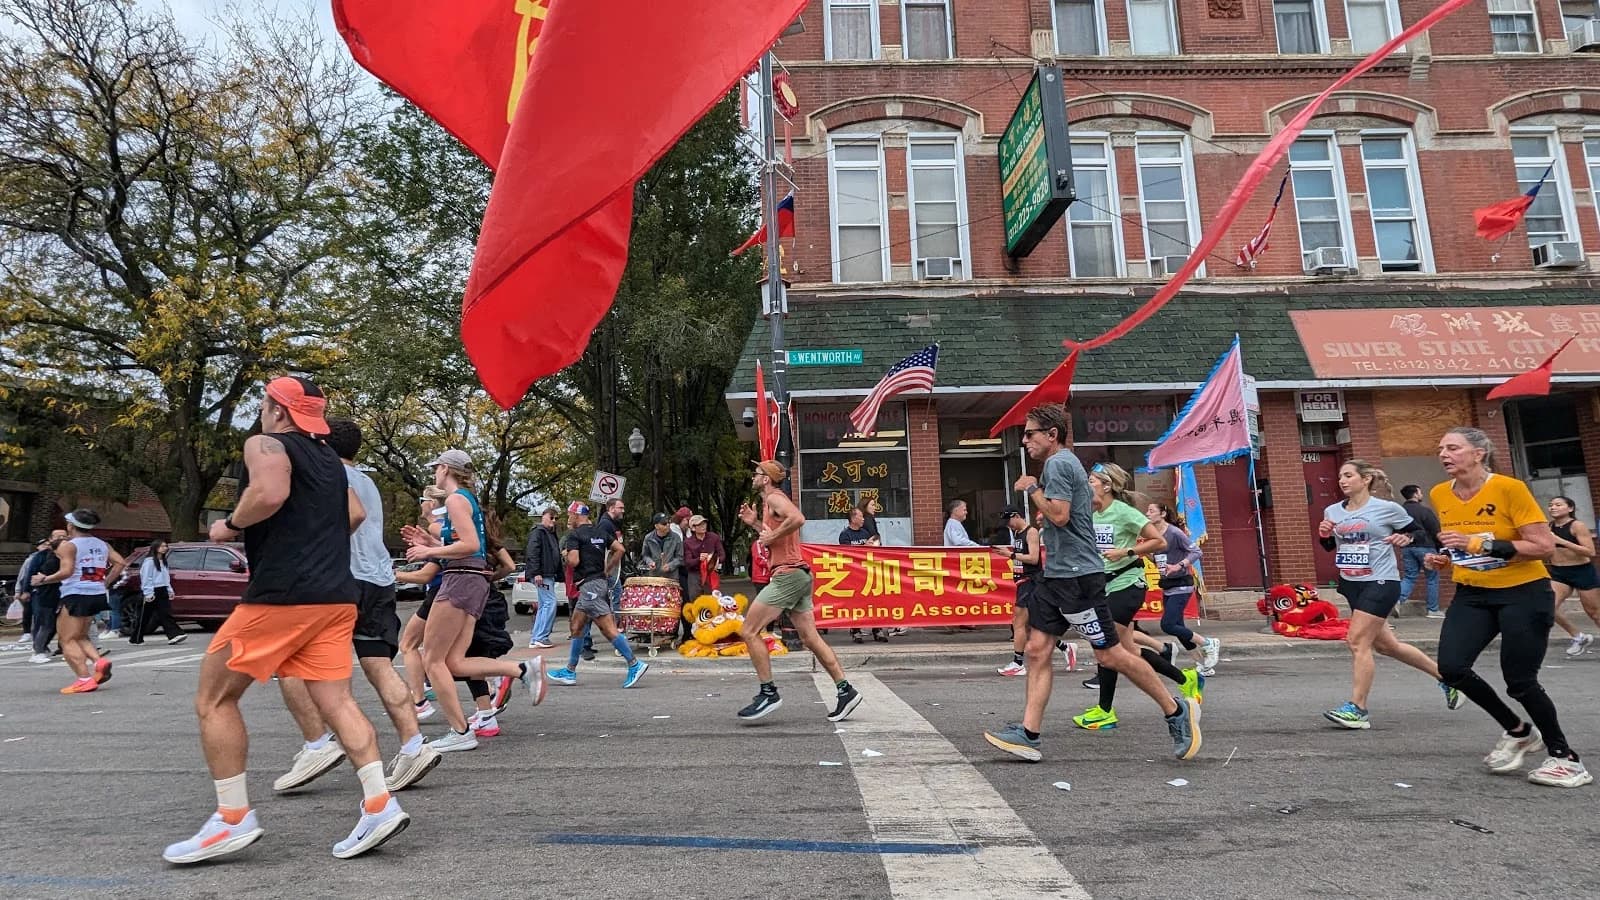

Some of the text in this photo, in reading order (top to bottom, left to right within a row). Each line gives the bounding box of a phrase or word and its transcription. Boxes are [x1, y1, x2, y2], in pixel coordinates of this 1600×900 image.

[1023, 121, 1036, 147] FOOD
[1322, 341, 1407, 358] SILVER
[1418, 339, 1495, 356] STATE
[1507, 338, 1561, 354] CITY
[792, 352, 797, 361] S
[797, 351, 852, 363] WENTWORTH
[1306, 393, 1332, 402] FOR
[1303, 402, 1337, 410] RENT
[804, 410, 850, 424] HONGKO
[1087, 420, 1129, 433] FOOD
[1342, 554, 1369, 564] 25828
[821, 601, 1013, 621] Enping Associat
